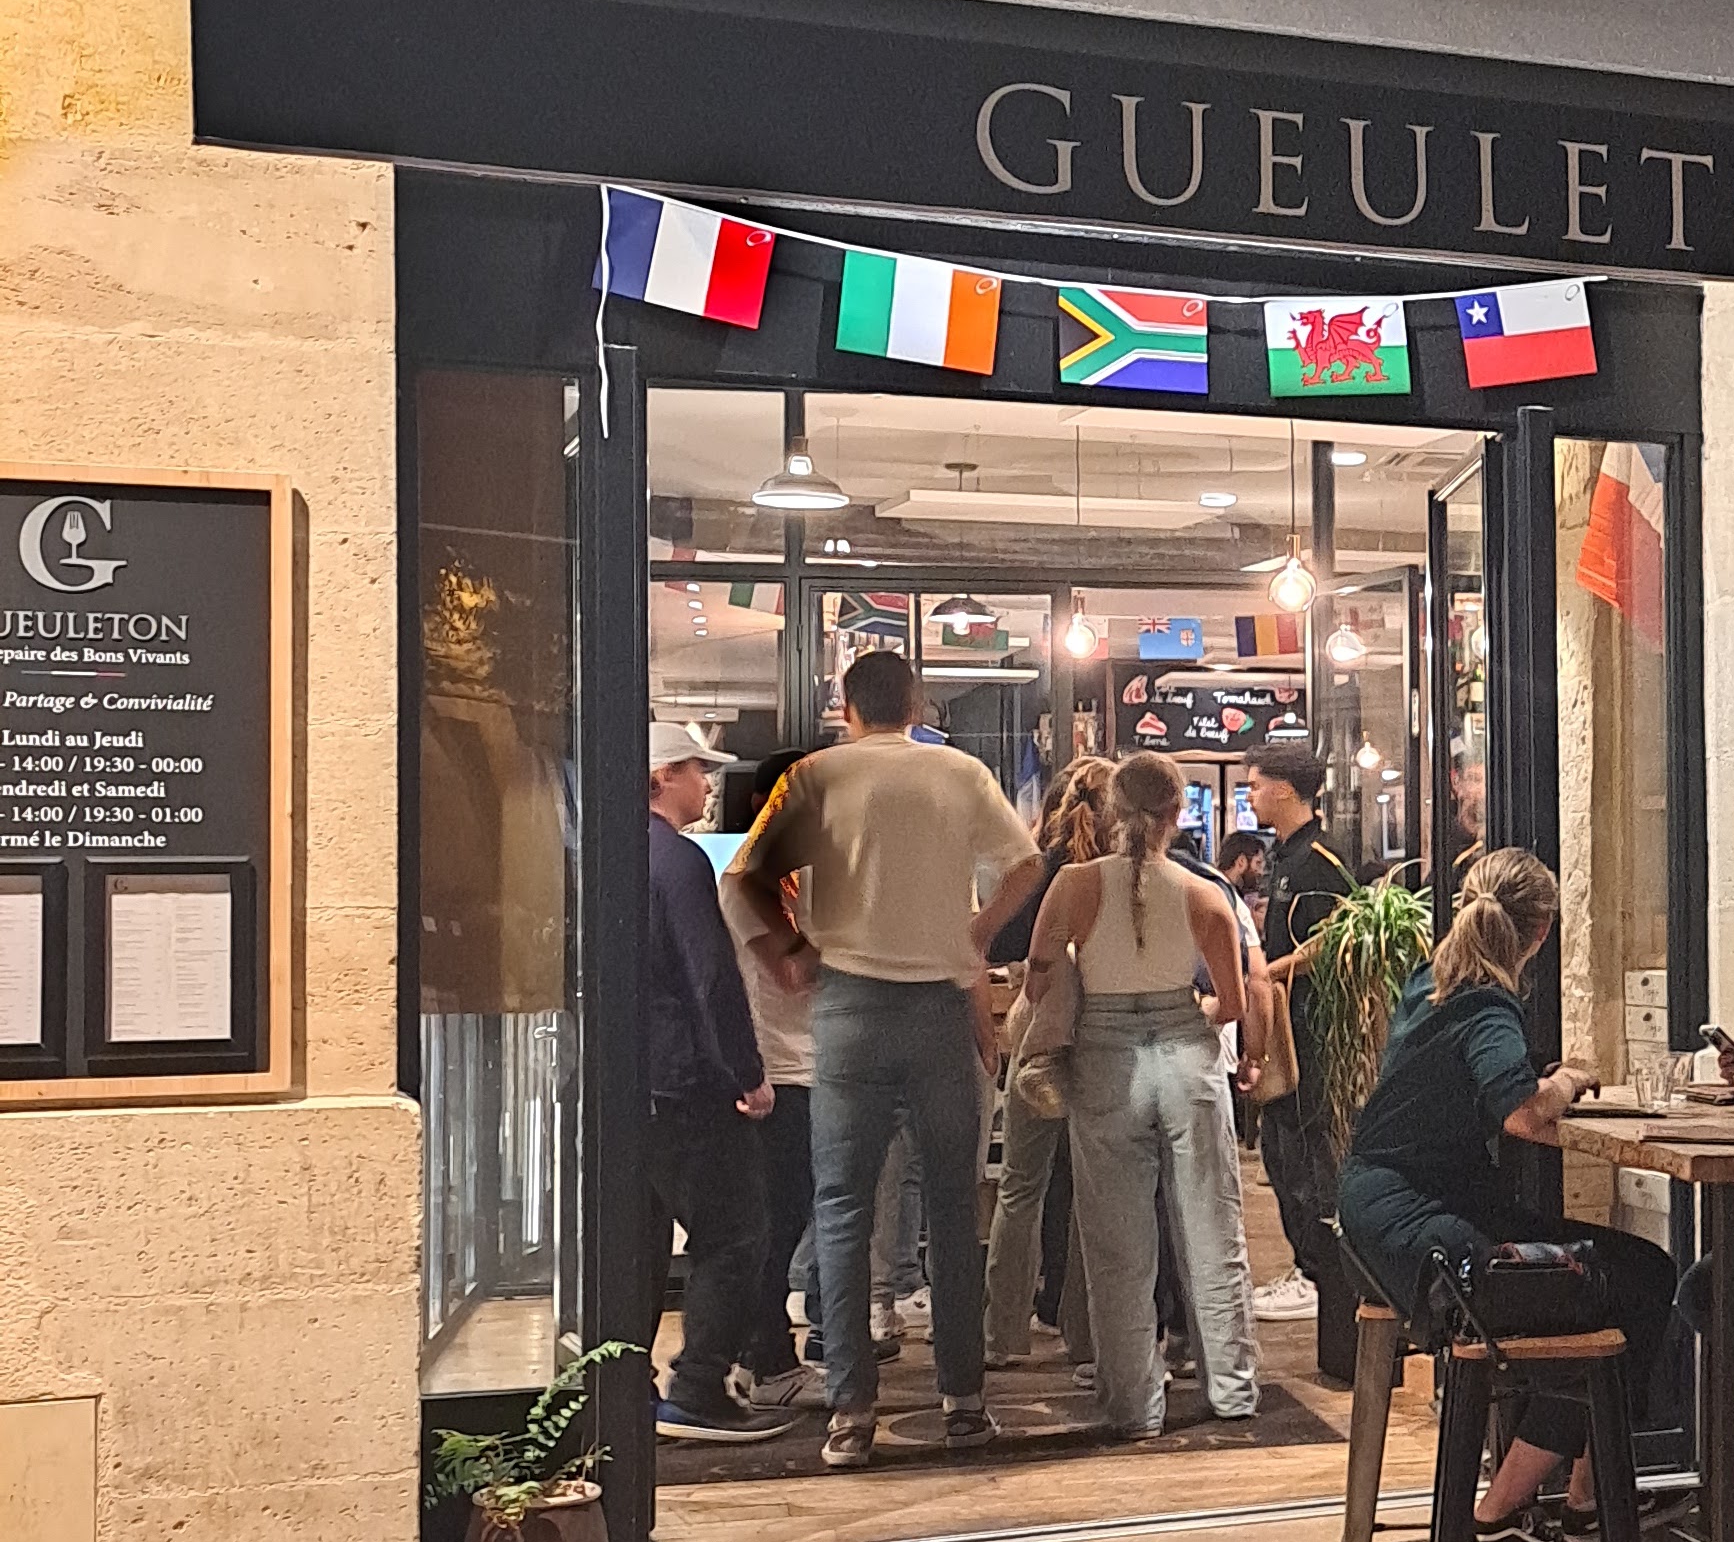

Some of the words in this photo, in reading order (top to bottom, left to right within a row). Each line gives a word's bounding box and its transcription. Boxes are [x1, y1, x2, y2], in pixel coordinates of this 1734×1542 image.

[50, 646, 78, 662] des
[83, 648, 125, 663] Bons
[127, 649, 190, 665] Vivants
[3, 690, 75, 713] Partage
[79, 693, 99, 709] &
[103, 693, 214, 711] Convivialité
[1, 730, 60, 747] Lundi
[65, 735, 89, 747] au
[93, 730, 144, 749] Jeudi
[12, 755, 63, 772] 14:00
[83, 757, 134, 773] 19:30
[151, 757, 203, 773] 00:00
[0, 780, 67, 797] ndredi
[71, 783, 90, 797] et
[94, 781, 166, 798] Samedi
[11, 806, 63, 822] 14:00
[83, 806, 134, 822] 19:30
[151, 807, 203, 823] 01:00
[44, 830, 62, 847] le
[66, 831, 167, 848] Dimanche
